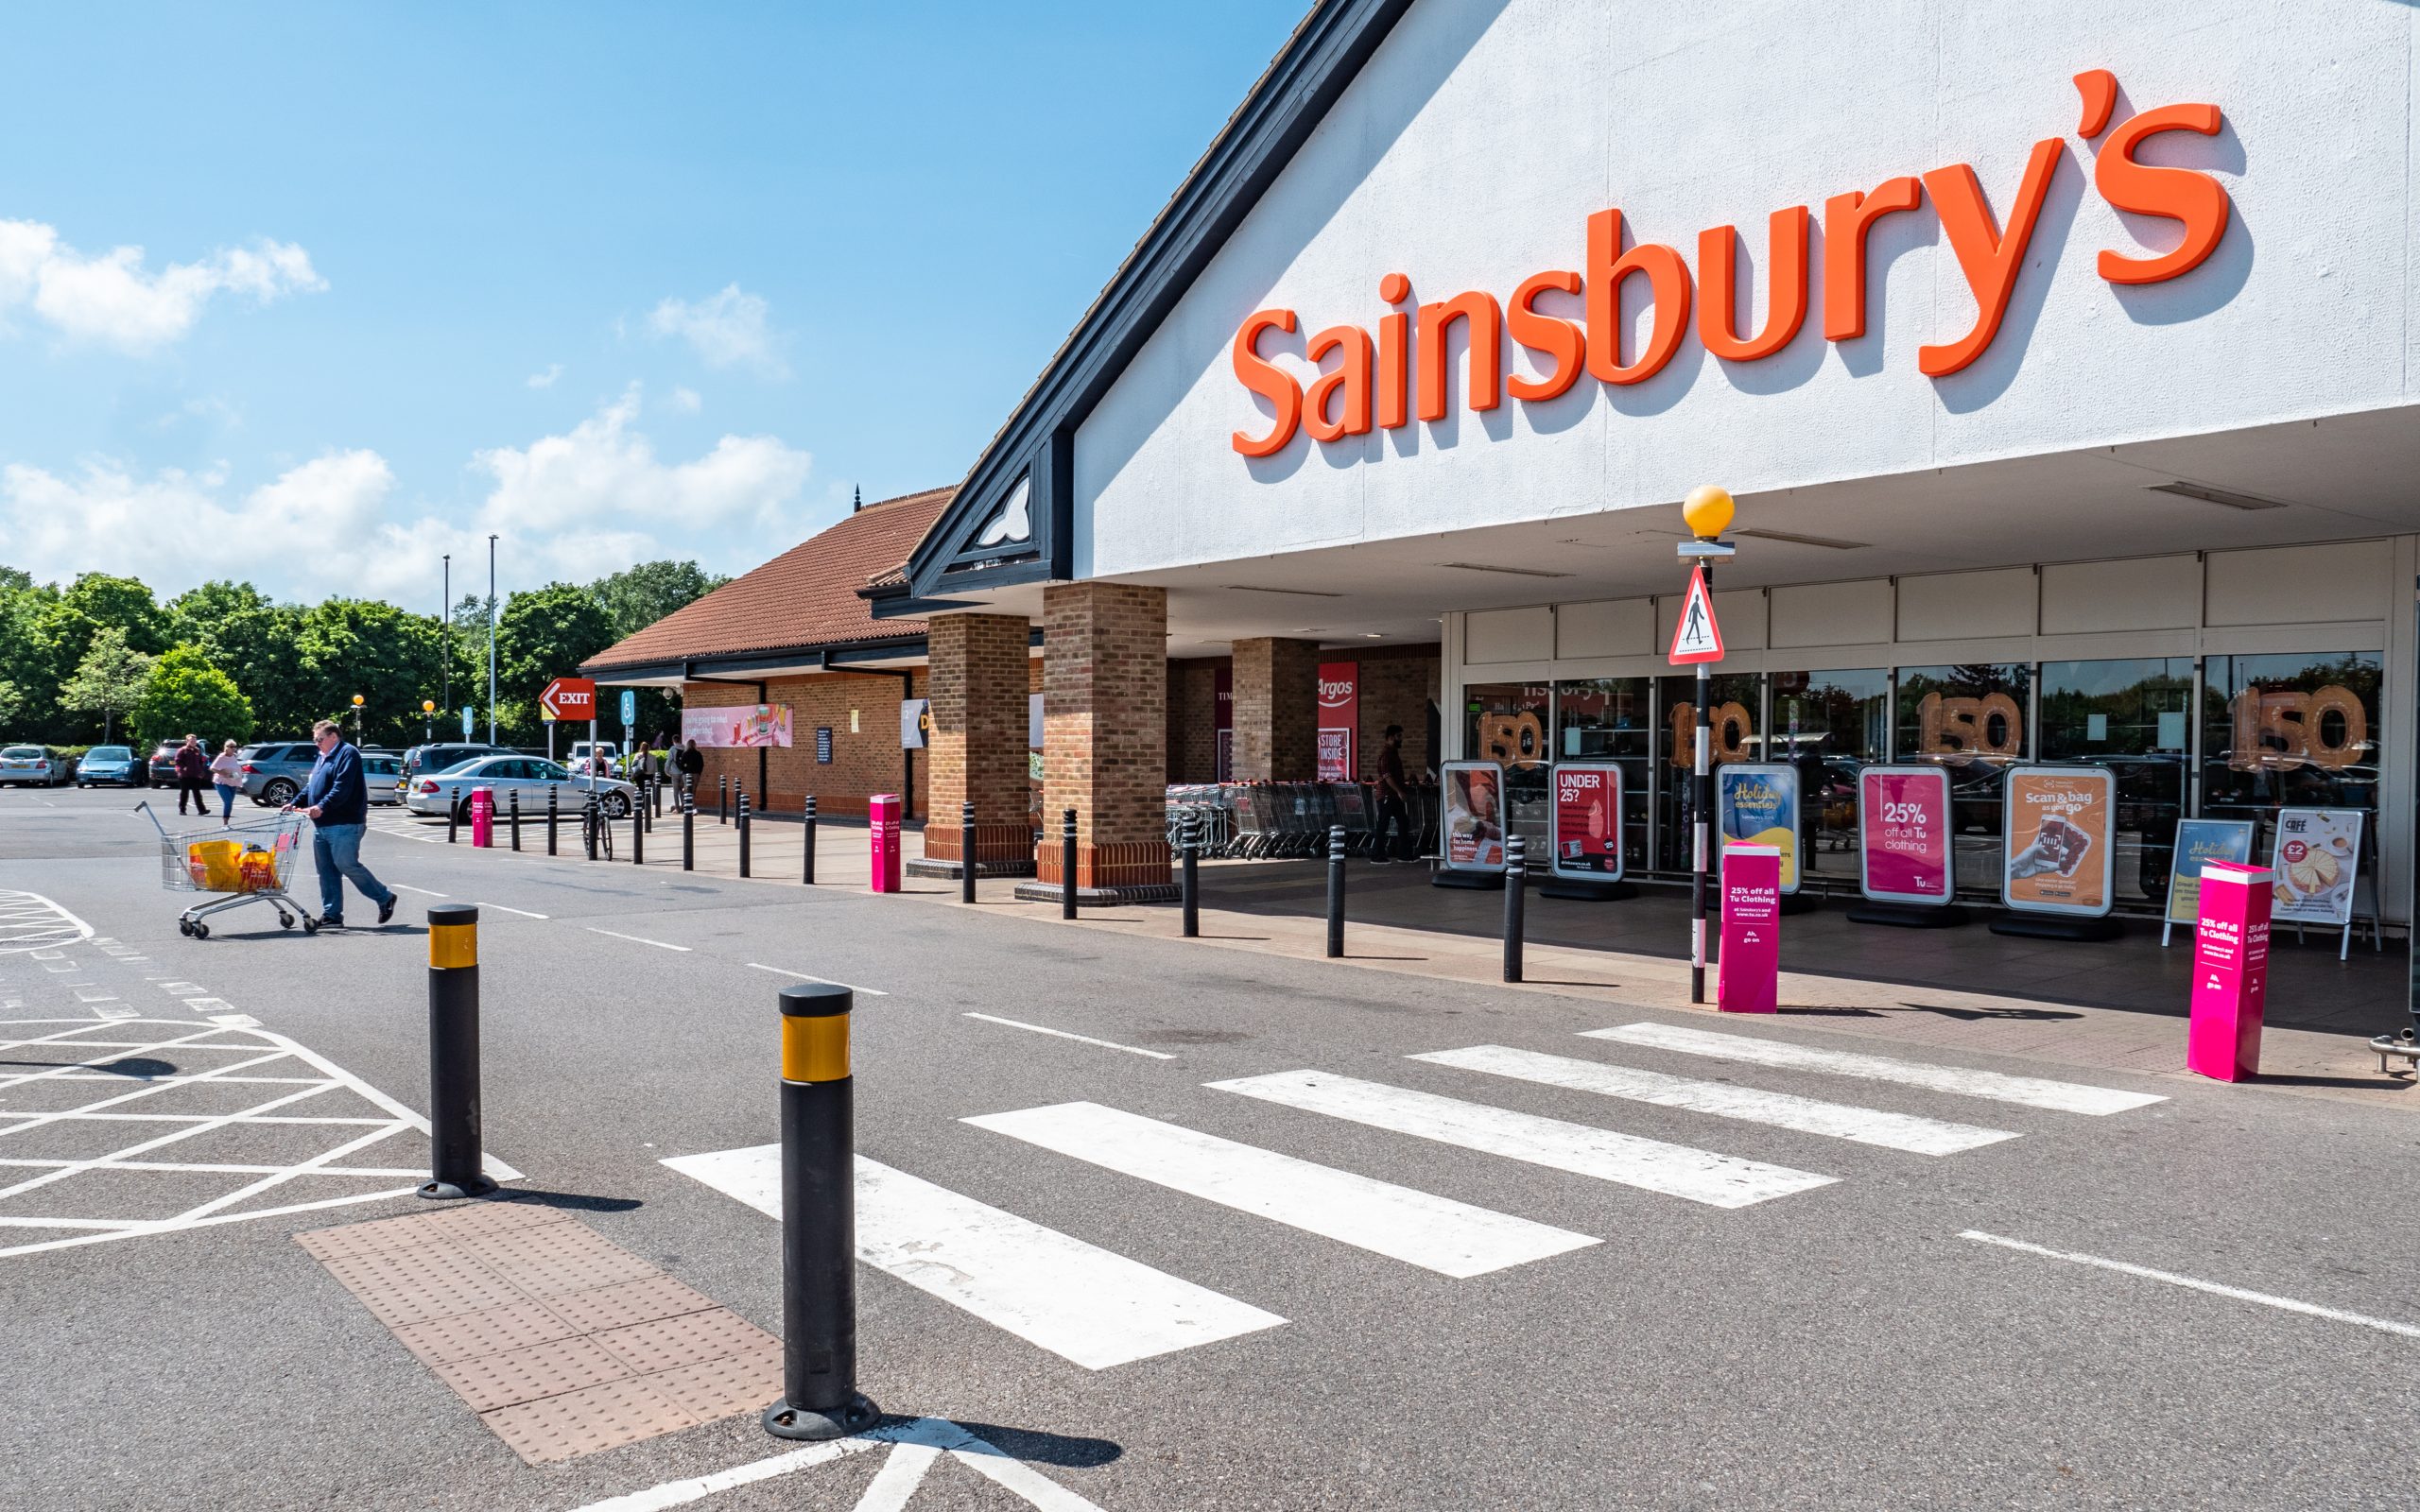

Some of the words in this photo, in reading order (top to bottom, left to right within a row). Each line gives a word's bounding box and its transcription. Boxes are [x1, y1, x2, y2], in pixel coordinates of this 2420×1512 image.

[1233, 70, 2230, 457] Sainsbury's
[1319, 679, 1353, 699] Argos
[559, 693, 590, 704] EXIT
[1916, 691, 2023, 767] 150
[1321, 734, 1341, 747] STORE
[1321, 747, 1341, 760] INSIDE
[1560, 774, 1599, 788] UNDER
[1560, 789, 1580, 801] 25?
[1735, 782, 1782, 806] Holiday
[2026, 793, 2055, 803] Scan
[2056, 794, 2067, 804] &
[2068, 791, 2092, 804] bag
[1736, 800, 1776, 810] essentials
[2066, 803, 2082, 815] go
[1884, 802, 1927, 824] 25%
[2286, 818, 2307, 831] CAFÉ
[1885, 828, 1899, 837] off
[1900, 828, 1911, 838] all
[1913, 826, 1927, 838] Tu
[1885, 840, 1927, 853] clothing
[2287, 845, 2303, 854] £2
[1913, 876, 1926, 887] Tu
[1741, 895, 1775, 904] Clothing
[2202, 918, 2216, 928] 25%
[2216, 921, 2228, 930] off
[2200, 927, 2207, 936] Tu
[2208, 930, 2238, 945] Clothing
